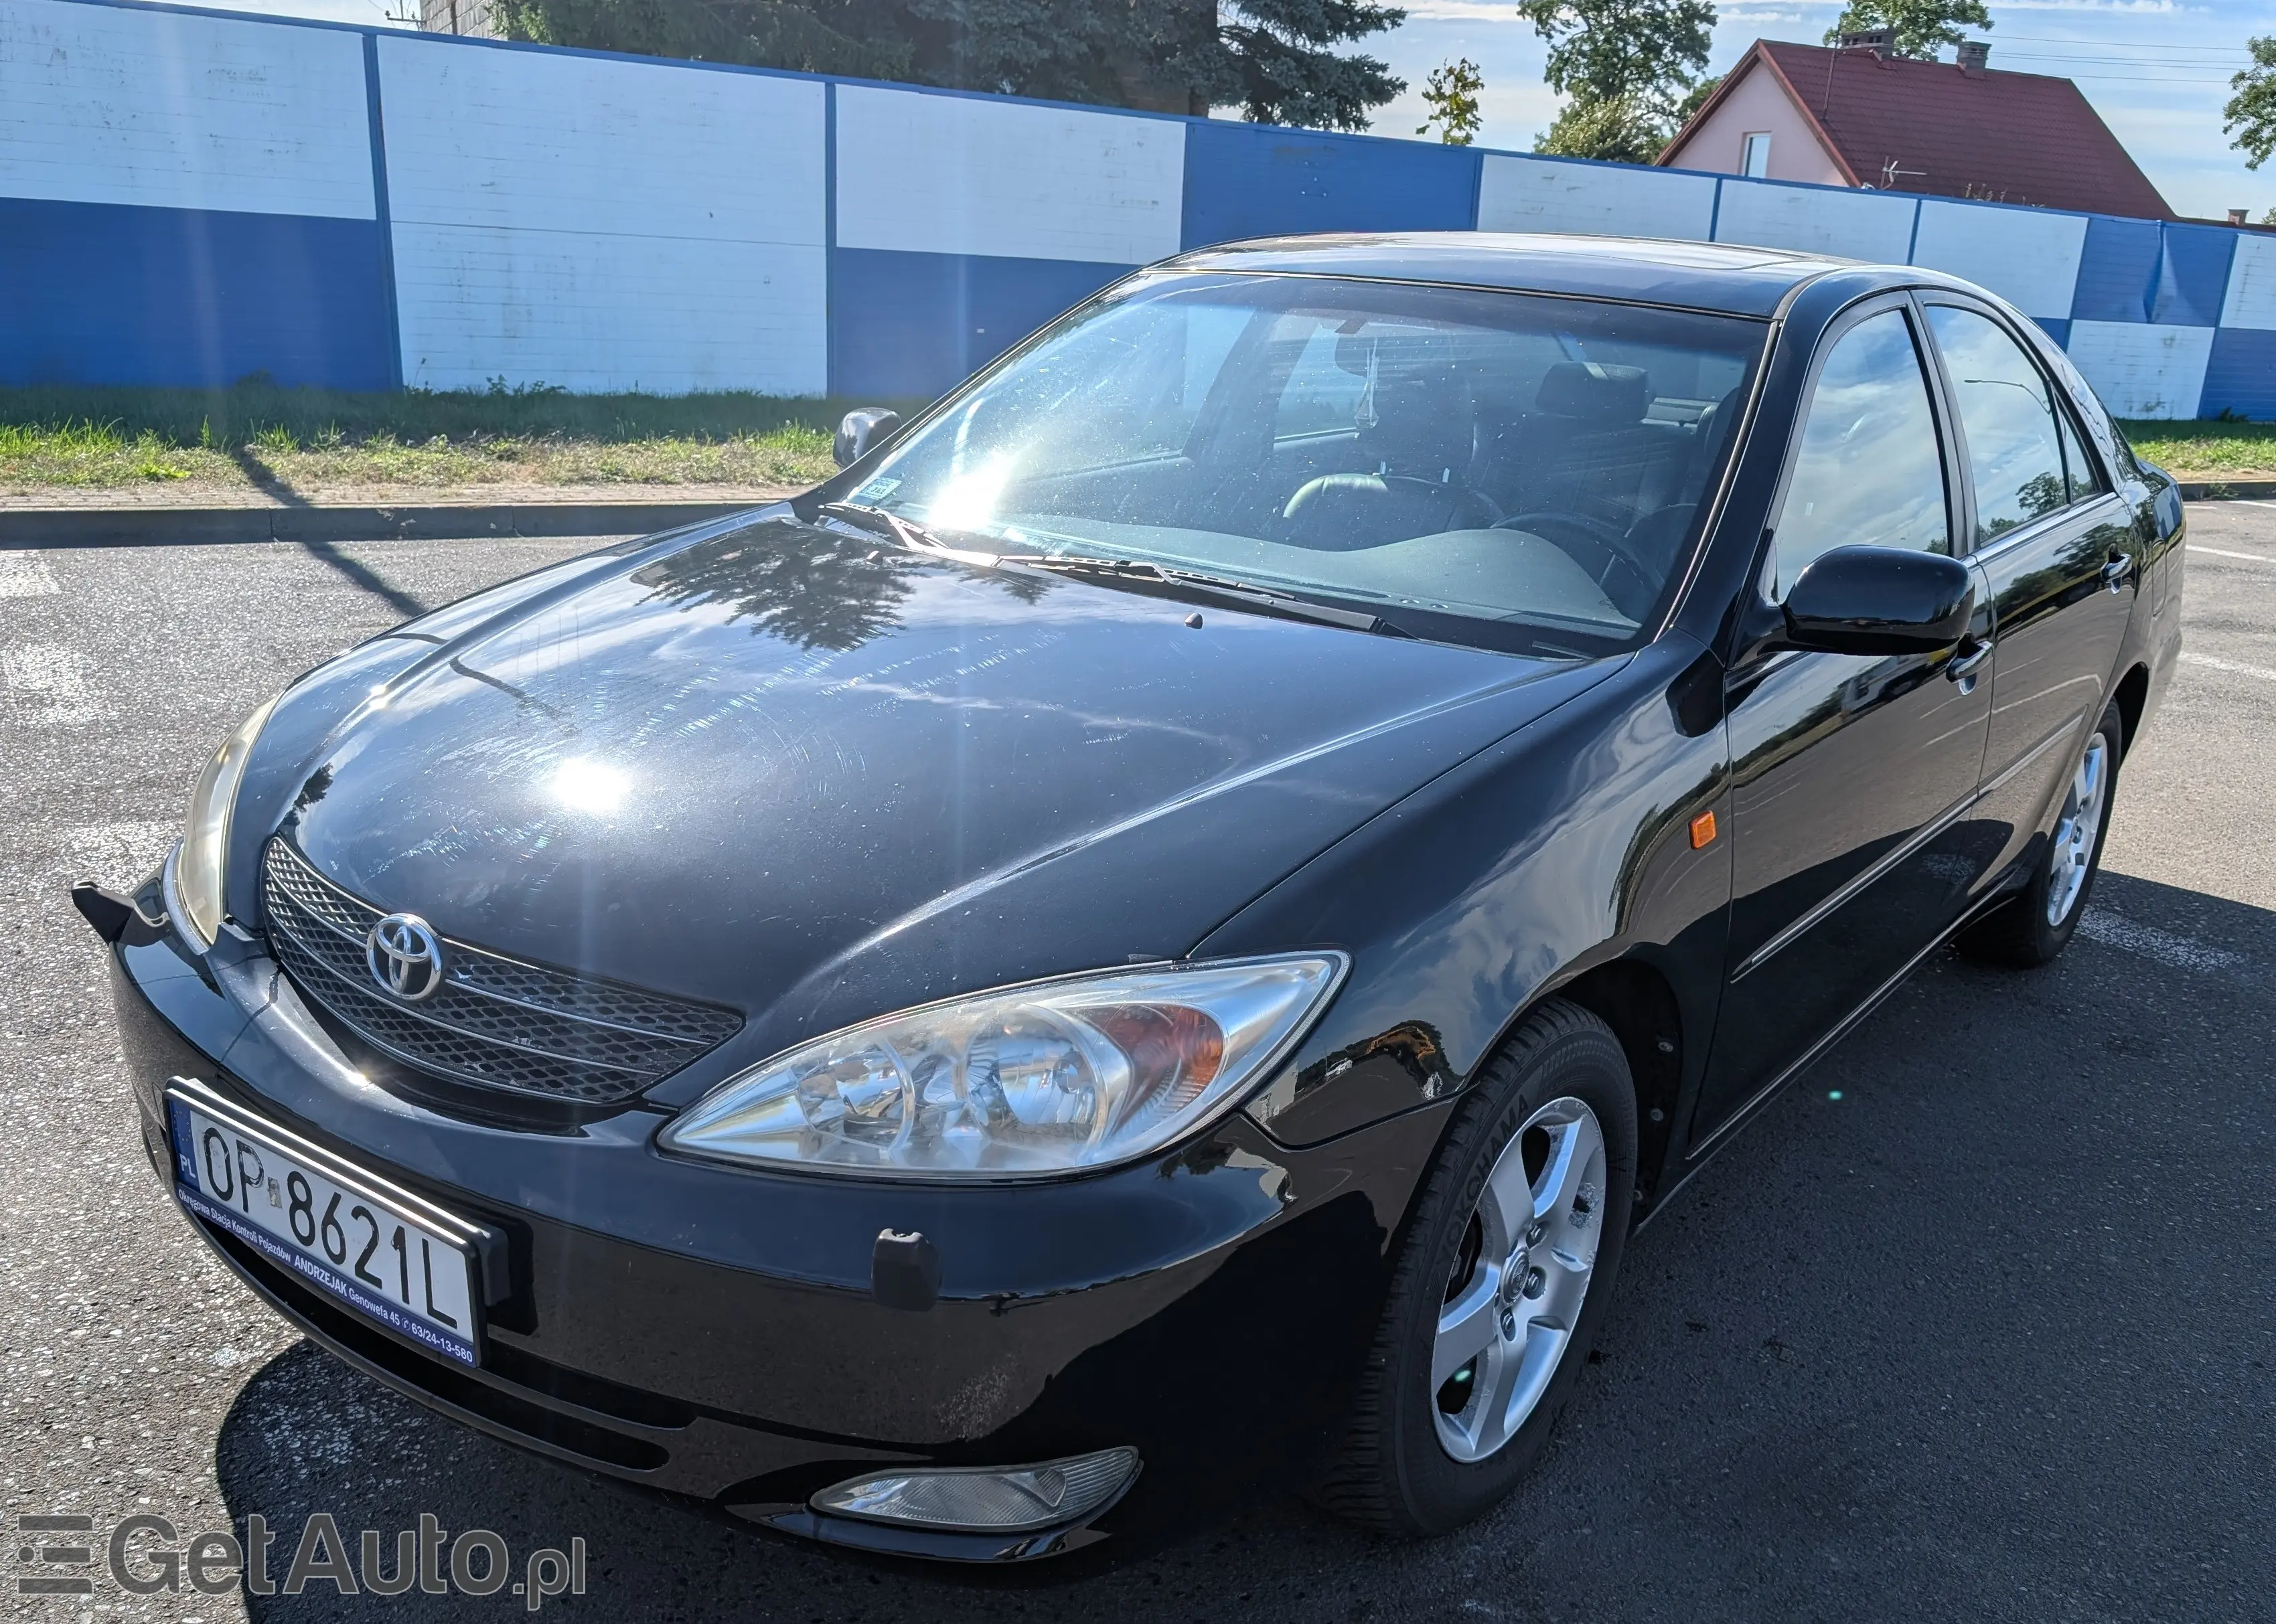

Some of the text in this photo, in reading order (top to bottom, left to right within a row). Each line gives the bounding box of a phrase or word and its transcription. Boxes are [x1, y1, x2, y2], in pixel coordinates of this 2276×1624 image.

[179, 1153, 196, 1179] PL
[204, 1127, 458, 1329] OP 8621L
[178, 1189, 473, 1362] Okręgowa Stacja Kontroli Pojazdów ANDRZEJAK Genowefa 45 63/24-13-580
